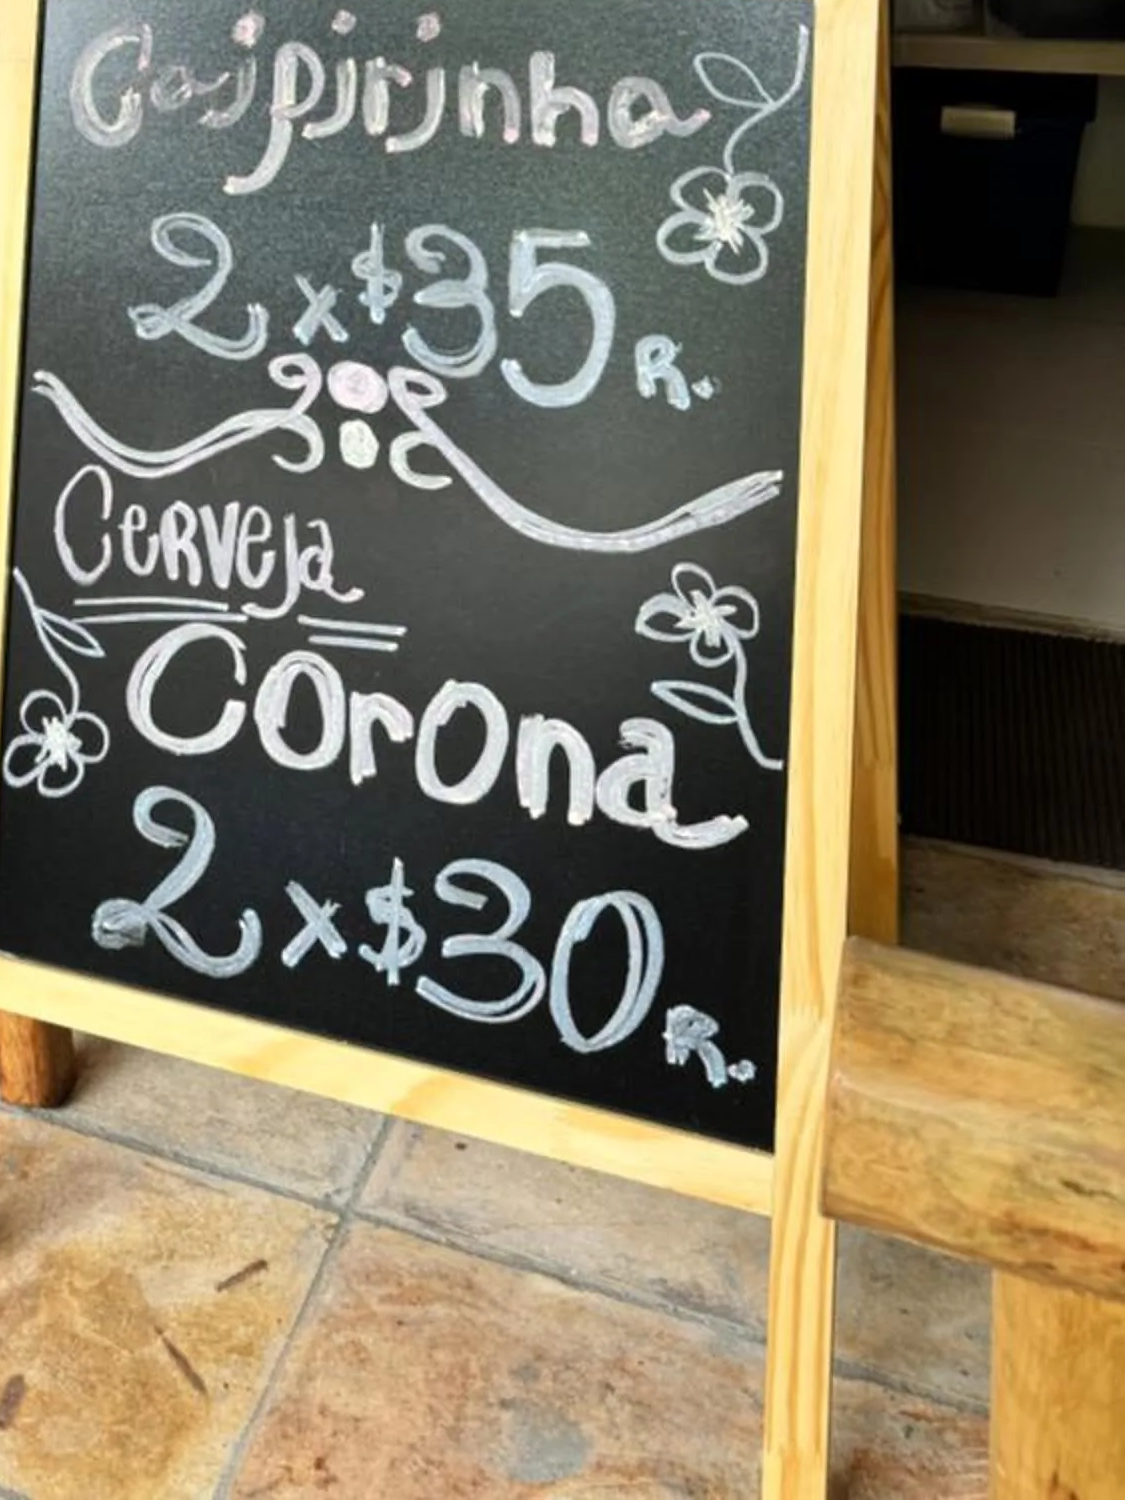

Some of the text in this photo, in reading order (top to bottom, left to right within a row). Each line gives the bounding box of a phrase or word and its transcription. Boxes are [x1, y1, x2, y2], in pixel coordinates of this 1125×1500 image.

[127, 211, 269, 362] 2
[351, 220, 617, 409] $35
[90, 785, 262, 979] 2
[359, 857, 665, 1054] $30
